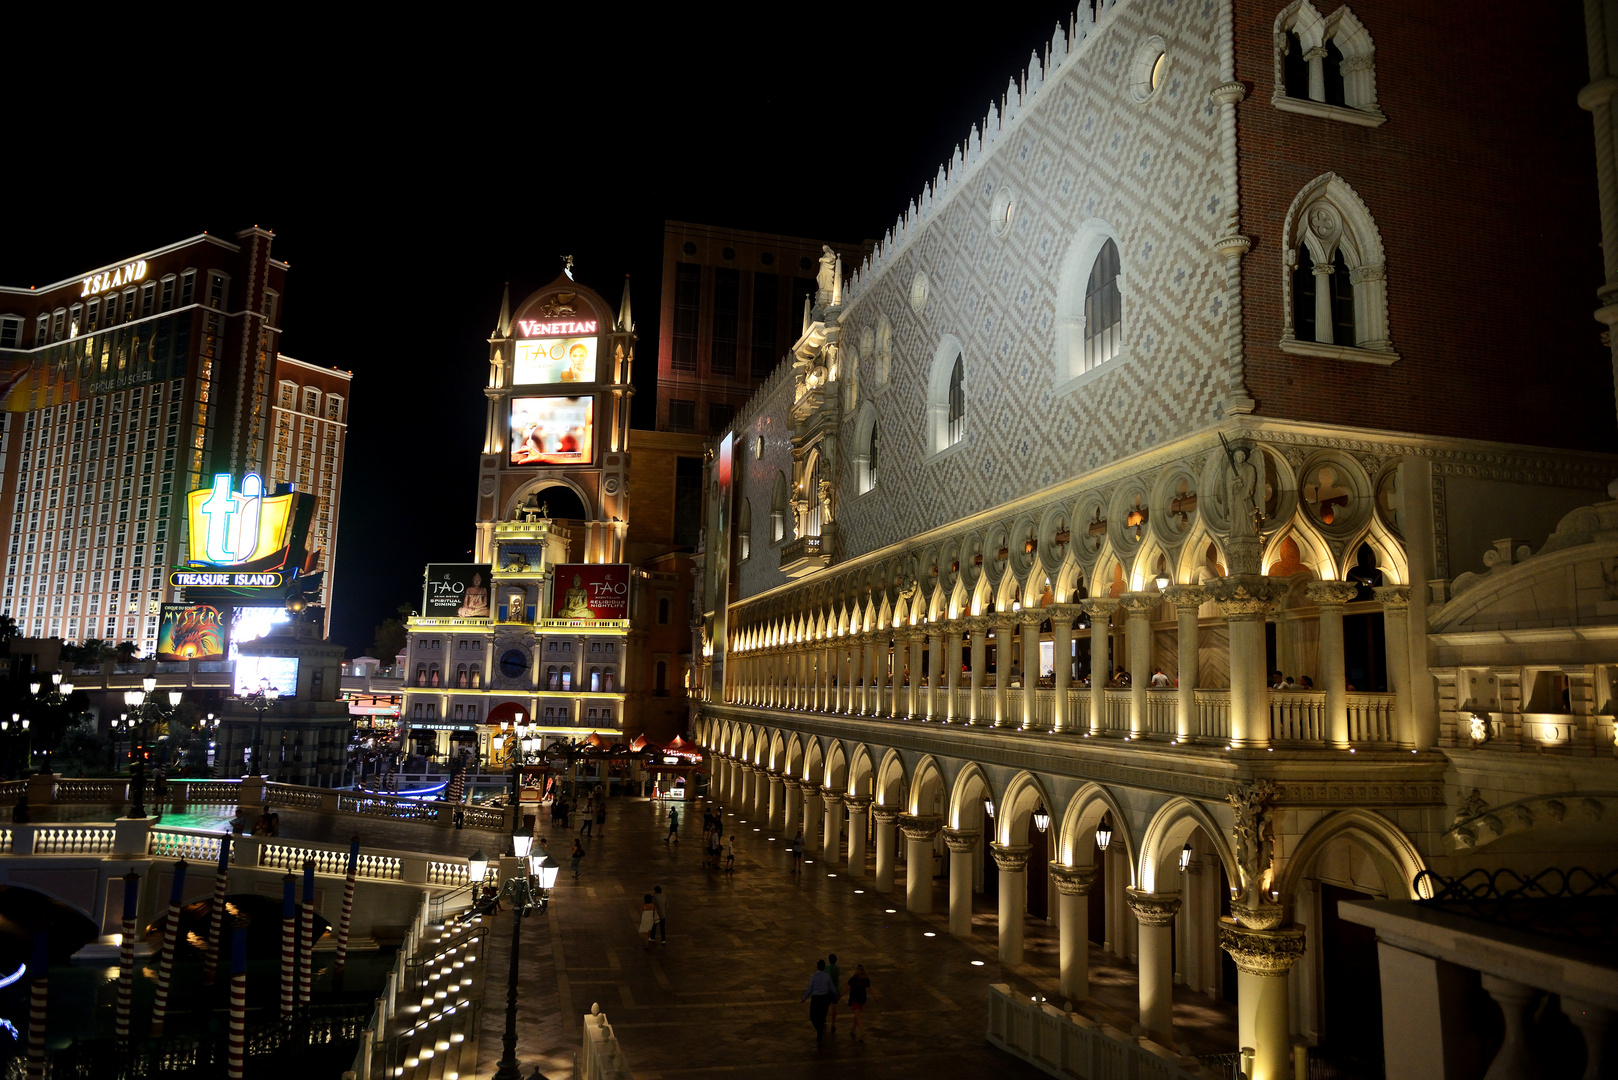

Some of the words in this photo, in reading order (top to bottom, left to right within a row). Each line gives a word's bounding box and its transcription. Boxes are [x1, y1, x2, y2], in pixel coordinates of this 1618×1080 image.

[80, 260, 147, 298] ISLAND
[518, 320, 597, 338] VENETIAN
[518, 343, 566, 362] TAO
[177, 573, 230, 585] TREASURE
[234, 573, 276, 586] ISLAND
[429, 581, 465, 594] TAO
[590, 582, 627, 595] TAO
